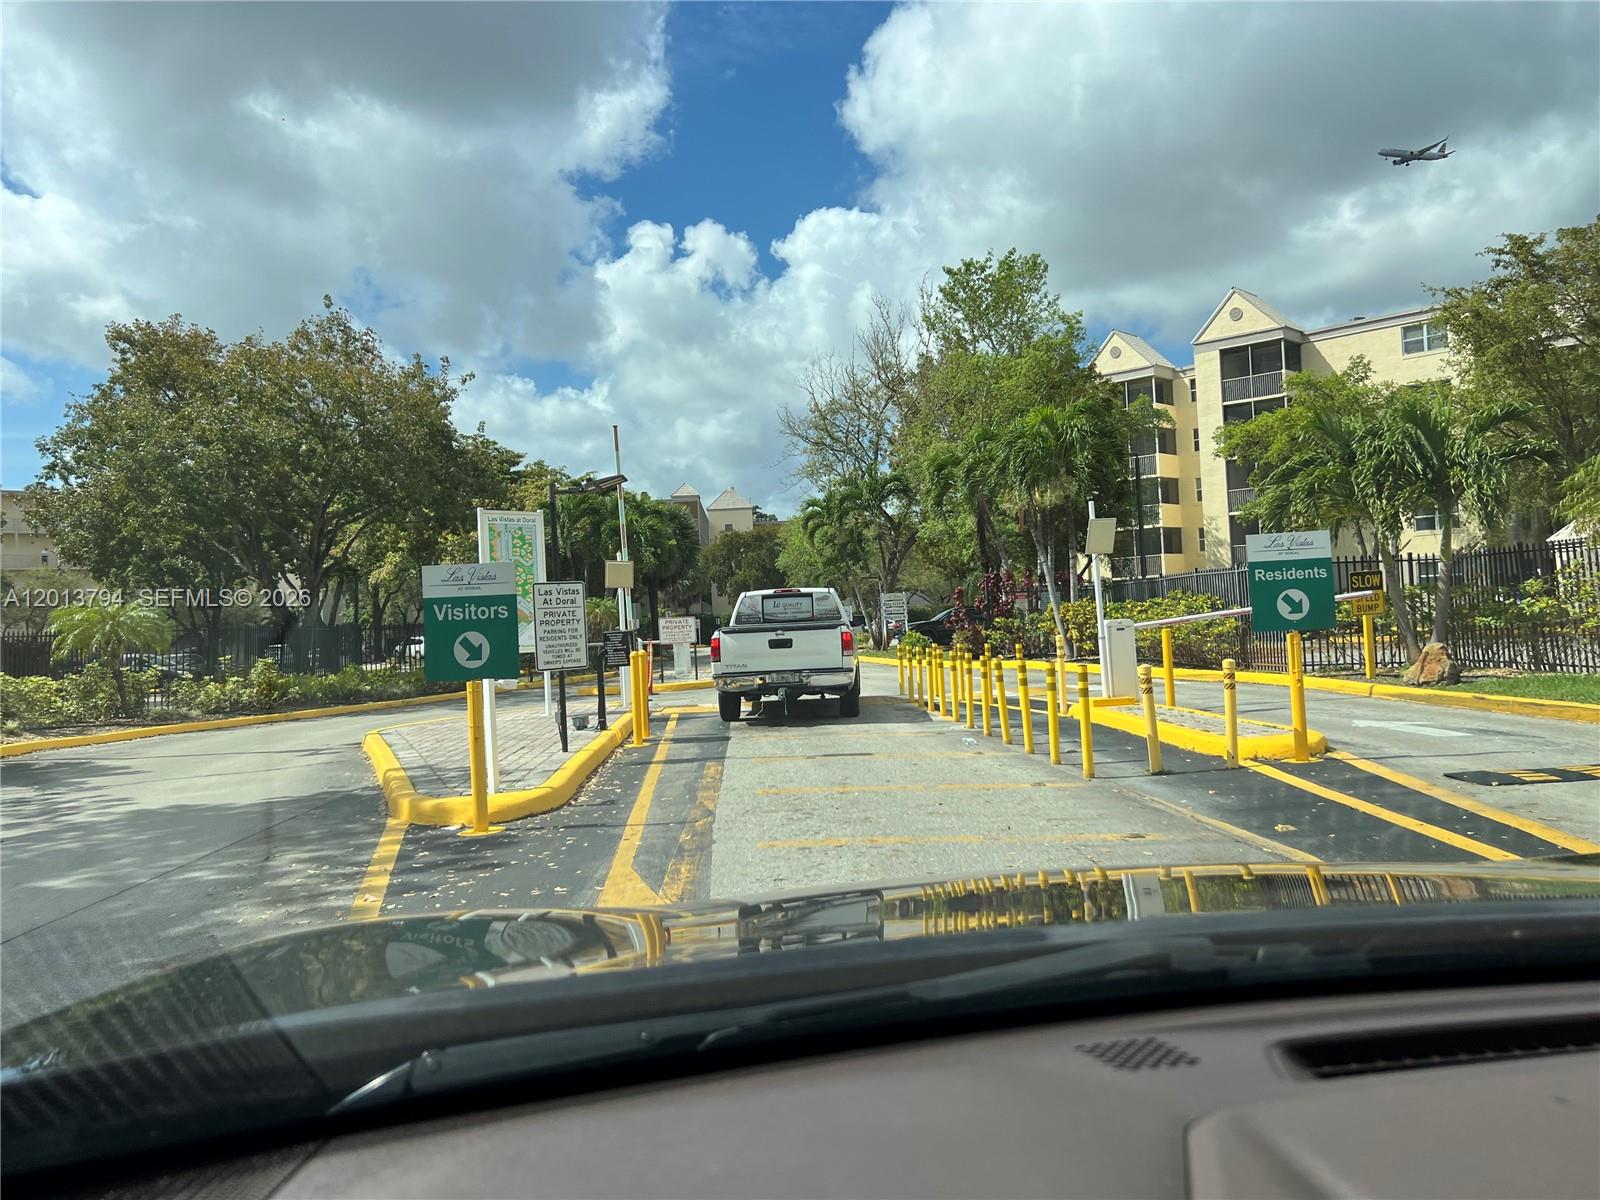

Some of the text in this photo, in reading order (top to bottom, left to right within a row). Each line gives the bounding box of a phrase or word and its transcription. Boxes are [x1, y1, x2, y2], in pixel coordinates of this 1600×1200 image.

[1264, 535, 1284, 548] Las
[441, 566, 497, 582] Las Vistas
[1254, 567, 1328, 581] Residents
[1352, 574, 1381, 588] SLOW
[538, 587, 580, 596] Las Vistas
[542, 597, 577, 606] At Doral
[433, 603, 509, 621] Visitors
[1356, 603, 1380, 613] BUMP
[543, 610, 577, 618] PRIVATE
[540, 618, 581, 626] PROPERTY
